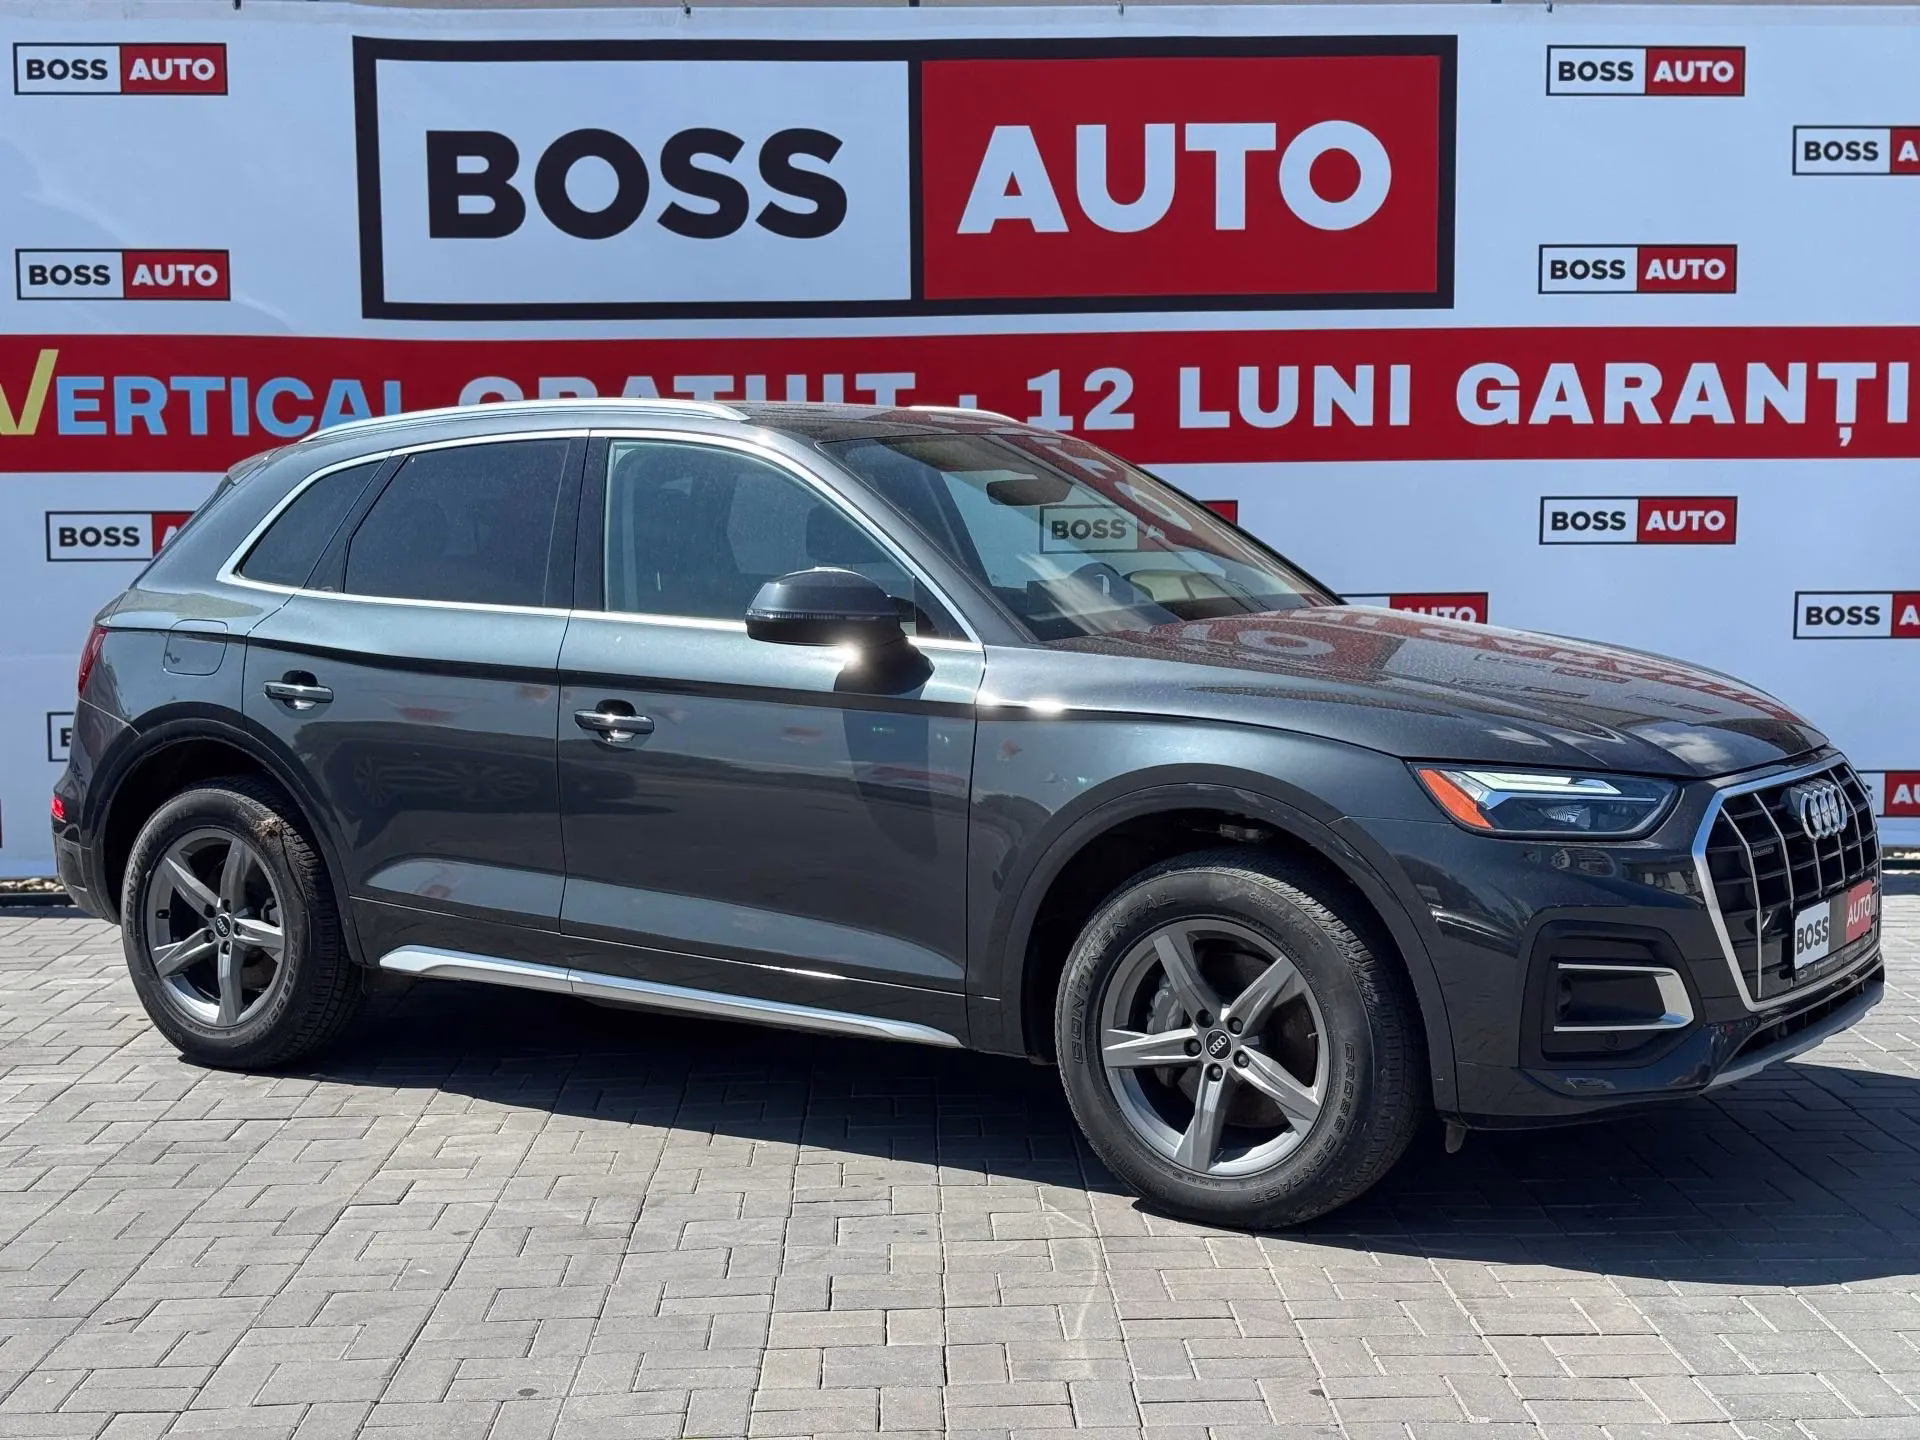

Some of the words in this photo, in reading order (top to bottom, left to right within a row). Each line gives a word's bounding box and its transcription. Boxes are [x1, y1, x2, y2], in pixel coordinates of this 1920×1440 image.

[26, 59, 108, 80] BOSS
[129, 59, 216, 81] AUTO
[1558, 61, 1634, 82] BOSS
[1653, 61, 1734, 82] AUTO
[1804, 141, 1879, 162] BOSS
[426, 128, 847, 239] BOSS
[957, 120, 1392, 233] AUTO
[28, 264, 110, 286] BOSS
[132, 265, 218, 286] AUTO
[1550, 259, 1626, 280] BOSS
[1645, 259, 1726, 280] AUTO
[1026, 367, 1135, 431] 12
[1179, 365, 1411, 429] LUNI
[1456, 362, 1909, 446] GARANȚI
[1051, 519, 1127, 540] BOSS
[1551, 511, 1626, 531] BOSS
[1645, 511, 1726, 532] AUTO
[58, 526, 141, 547] BOSS
[1805, 606, 1881, 626] BOSS
[1796, 916, 1829, 955] BOSS
[1847, 894, 1871, 927] AUTO
